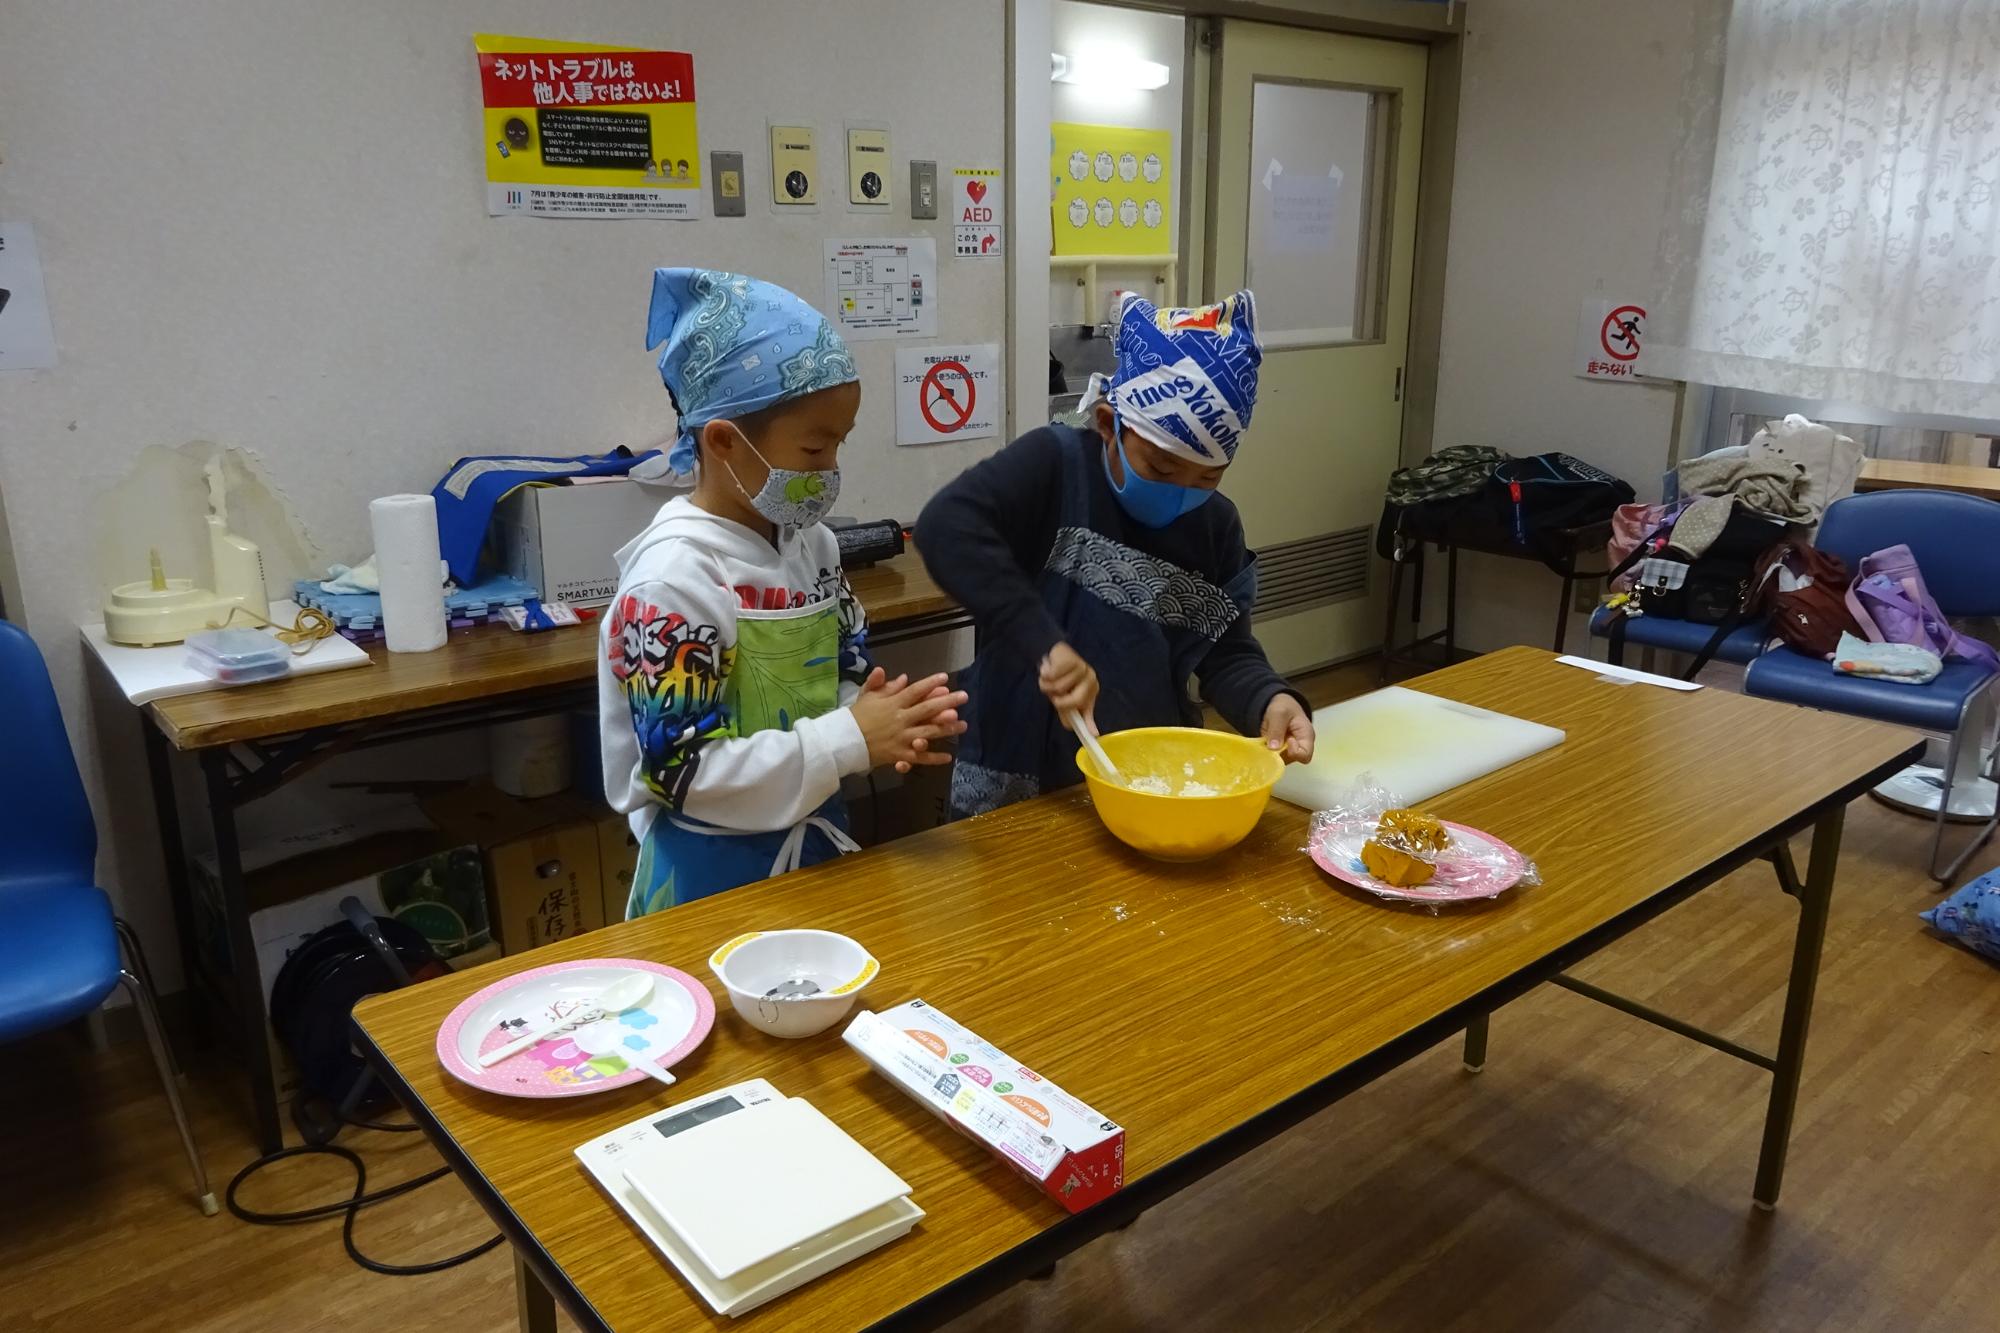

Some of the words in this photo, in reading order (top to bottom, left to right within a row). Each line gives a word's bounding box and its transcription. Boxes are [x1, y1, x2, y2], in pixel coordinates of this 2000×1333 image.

[494, 58, 636, 81] ネットトラブルは
[963, 207, 992, 222] AED
[957, 234, 978, 243] この先
[957, 246, 978, 255] 事務室
[1587, 360, 1635, 377] 走らない
[557, 585, 618, 602] SMARTVAL
[538, 887, 569, 941] 保存
